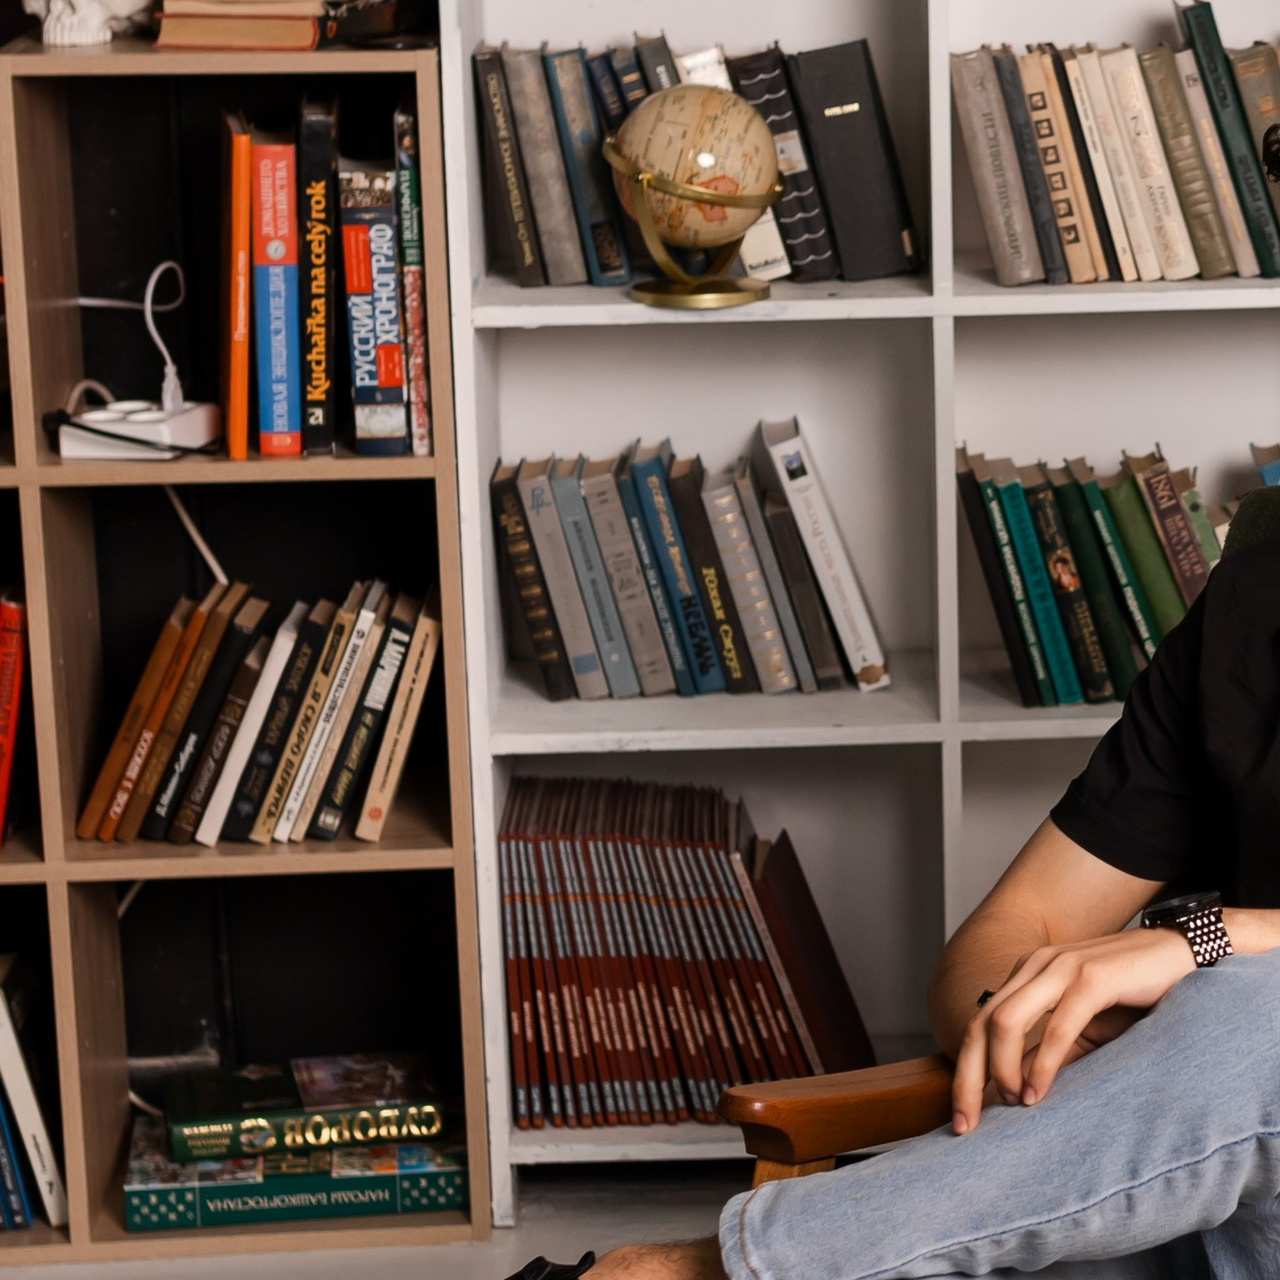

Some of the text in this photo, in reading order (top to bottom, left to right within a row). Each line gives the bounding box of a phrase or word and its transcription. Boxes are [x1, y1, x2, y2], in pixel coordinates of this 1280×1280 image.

[978, 110, 1005, 177] ПОВЕСТИ
[259, 158, 274, 237] ДОМАШНЕГО
[274, 159, 288, 236] ХОЗЯЙСТВА
[233, 275, 246, 341] Праздничный
[306, 178, 330, 400] Kuchařka na celý rok
[367, 222, 399, 344] ХРОНОГРАФ
[268, 265, 288, 431] НОВАЯ ЭНЦИКЛОПЕДИЯ
[347, 293, 377, 388] РУССКИЙ
[987, 498, 1010, 545] ЦЕЛИНА
[1000, 543, 1026, 600] ПОДНЯТАЯ
[700, 563, 744, 680] Юхан Смуул
[1122, 585, 1150, 640] ПОДНЯТАЯ
[287, 703, 317, 757] СКОРО
[281, 1101, 441, 1148] СУВОРОВ
[204, 1187, 389, 1212] НАРОДЫ БАШКОРТОСТАНА
